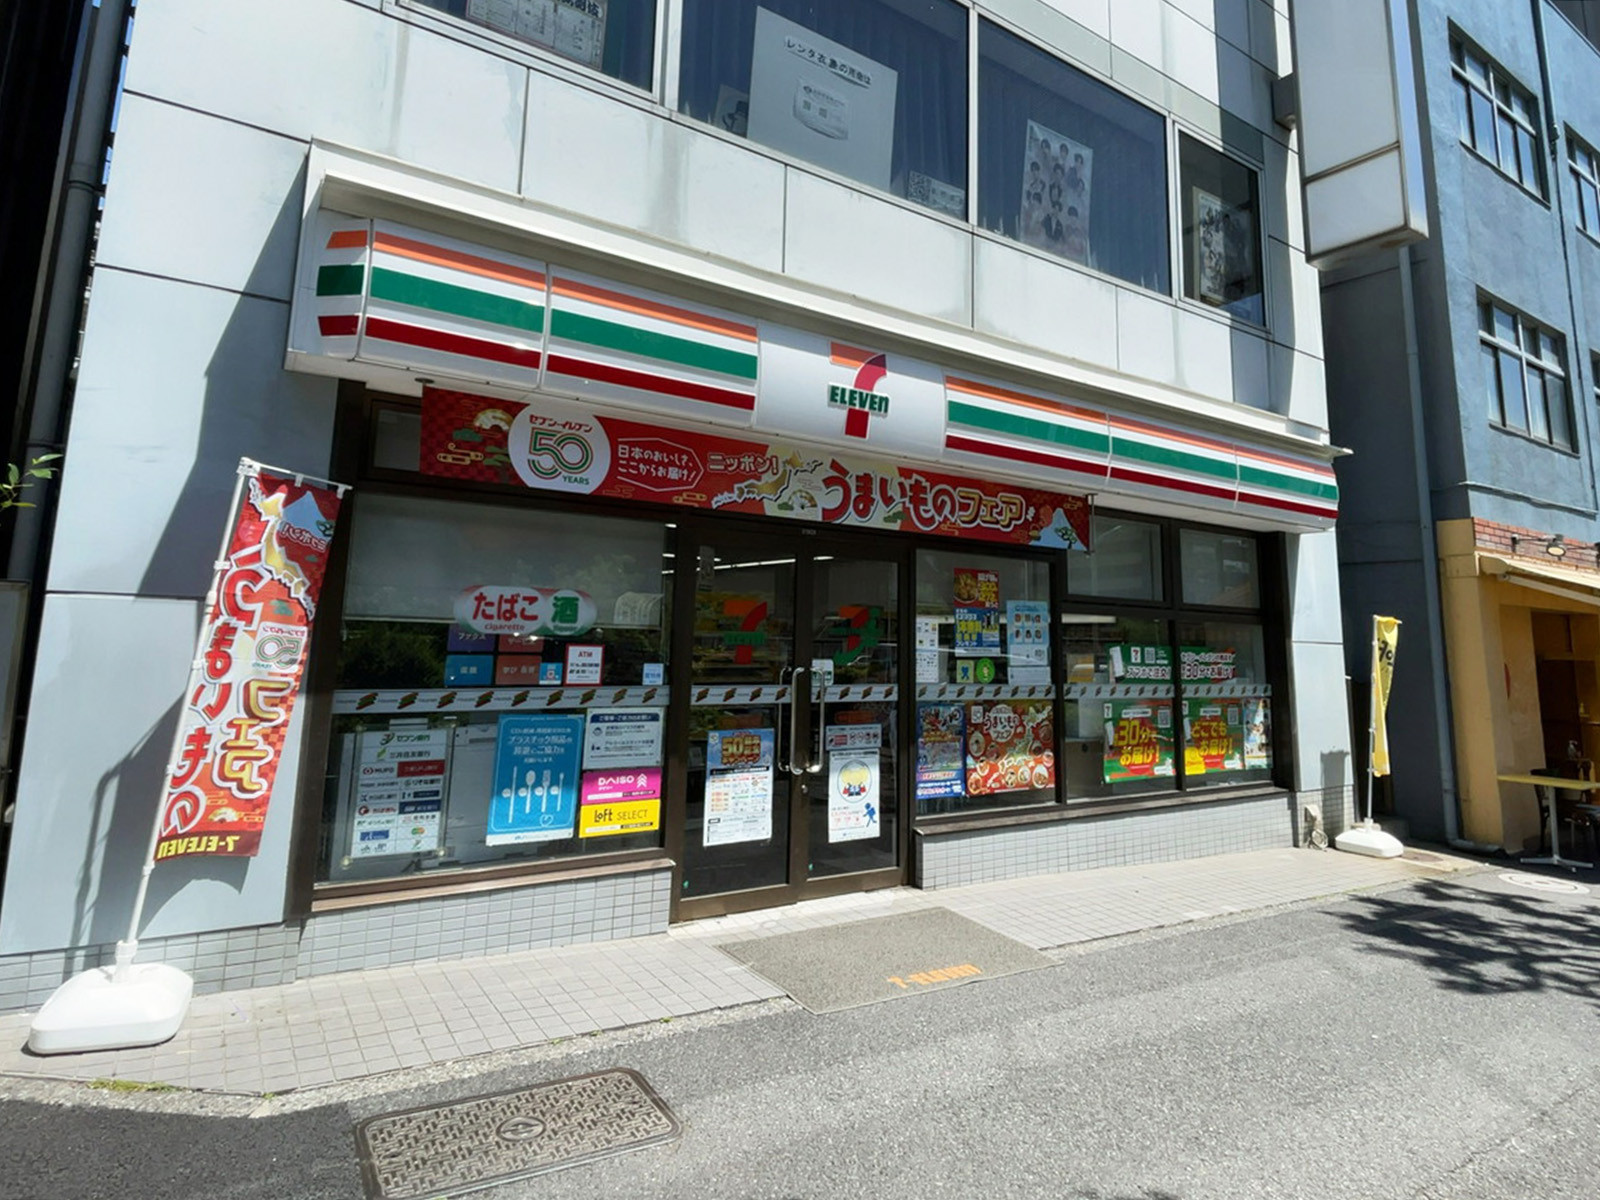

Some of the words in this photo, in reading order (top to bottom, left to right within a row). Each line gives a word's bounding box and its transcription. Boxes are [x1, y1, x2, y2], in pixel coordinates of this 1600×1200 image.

[830, 342, 887, 438] 7
[528, 427, 593, 480] 50
[563, 474, 590, 485] YEARS
[472, 592, 539, 622] たばこ
[552, 596, 580, 624] 酒
[578, 650, 593, 658] ATM
[1120, 745, 1159, 765] お届け!
[1200, 738, 1233, 756] お届け!
[598, 775, 635, 786] DAISO
[616, 809, 648, 821] SELECT
